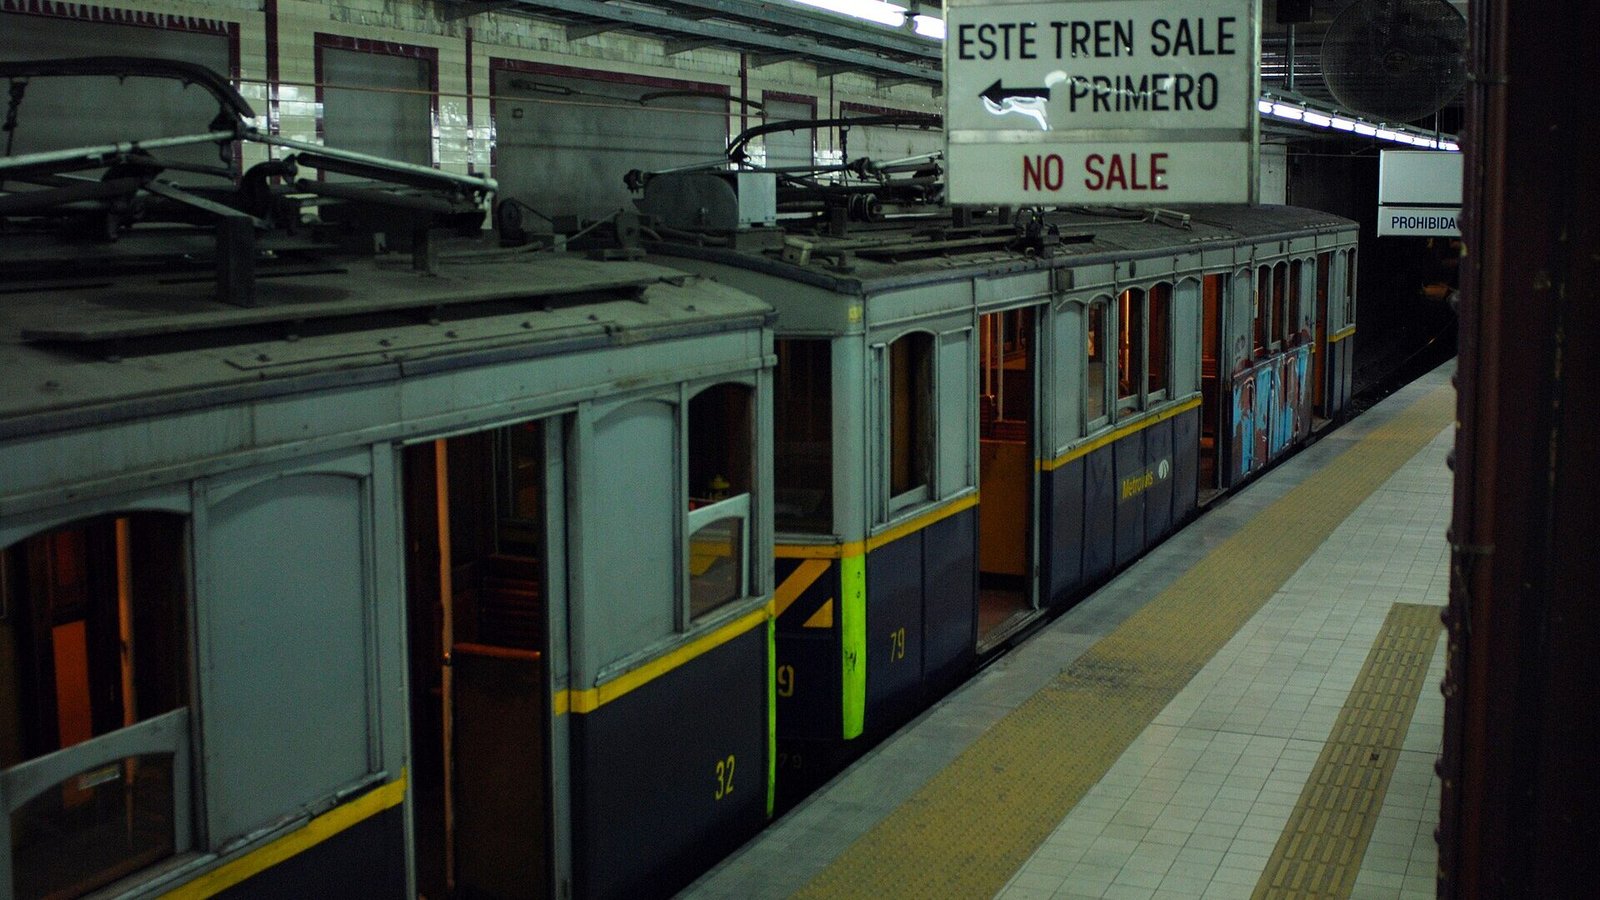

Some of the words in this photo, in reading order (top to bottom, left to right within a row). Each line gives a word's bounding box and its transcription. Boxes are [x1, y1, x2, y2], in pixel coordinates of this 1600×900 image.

[958, 23, 1036, 60] ESTE
[1051, 19, 1133, 58] TREN
[1151, 17, 1236, 56] SALE
[1070, 73, 1219, 113] PRIMERO
[1022, 153, 1065, 191] NO
[1084, 152, 1169, 191] SALE
[1391, 216, 1457, 230] PROHIBIDA
[890, 627, 906, 663] 79
[777, 664, 796, 698] 9
[714, 753, 737, 801] 32
